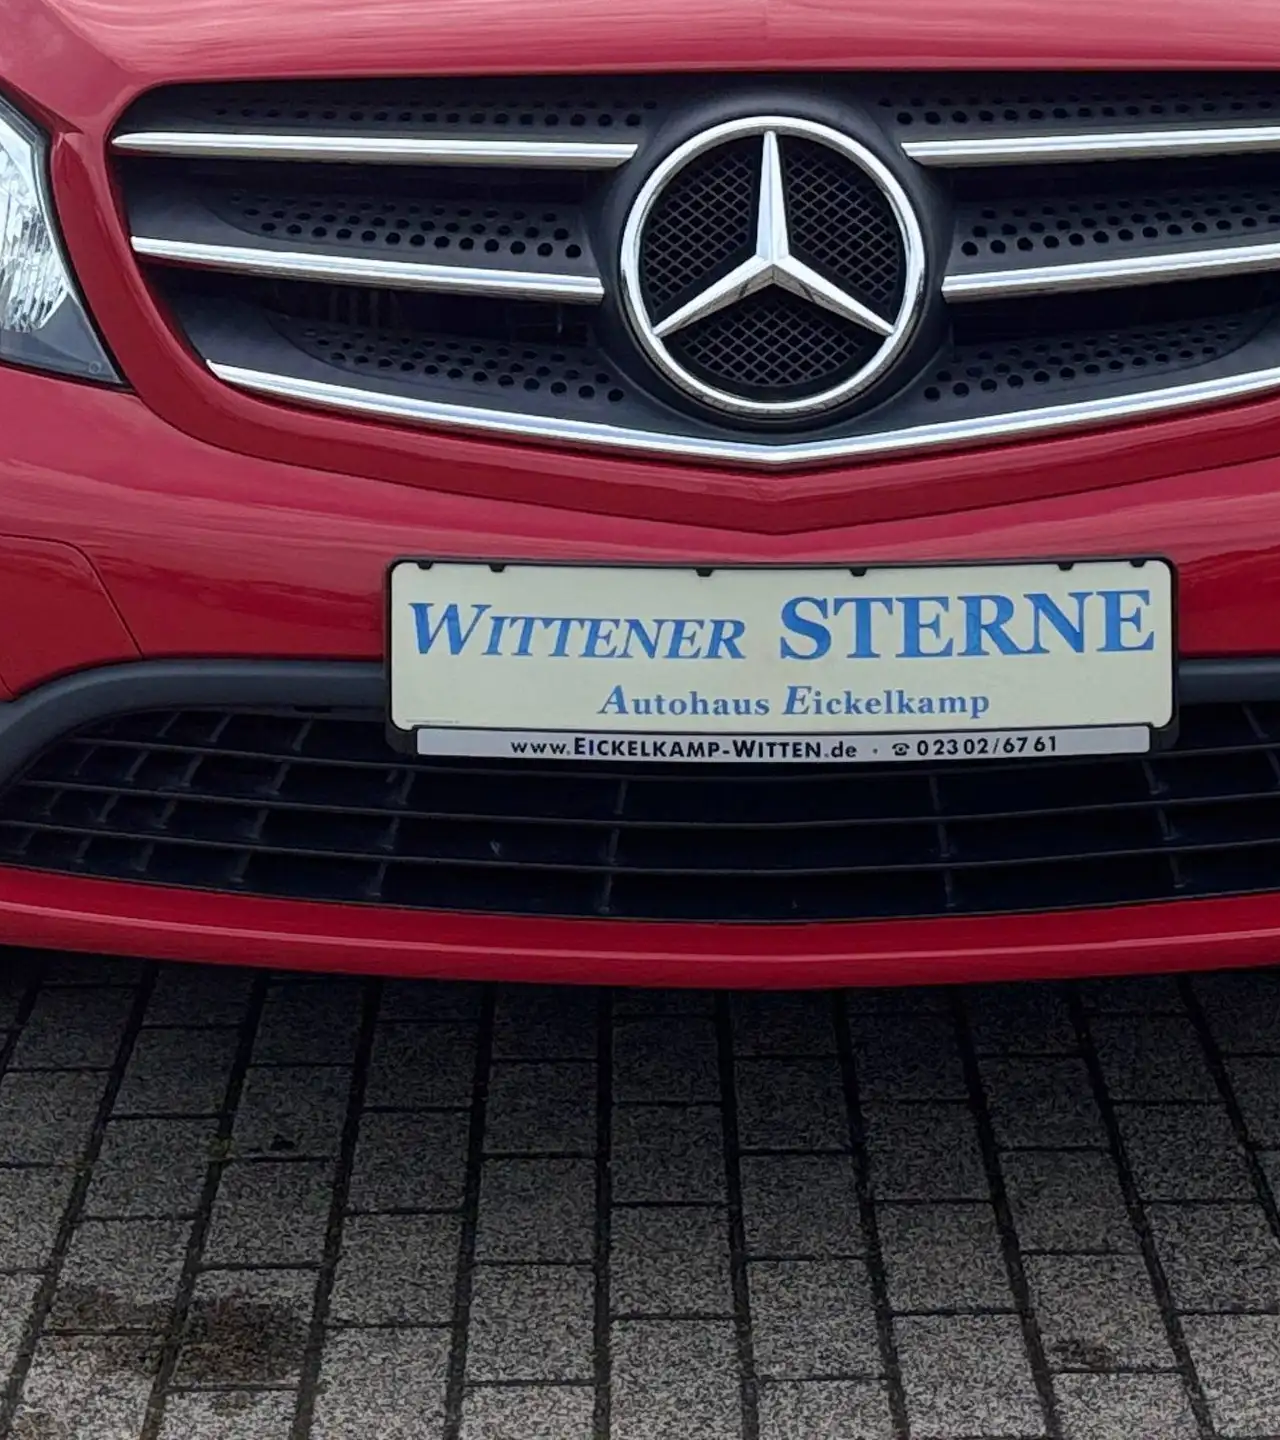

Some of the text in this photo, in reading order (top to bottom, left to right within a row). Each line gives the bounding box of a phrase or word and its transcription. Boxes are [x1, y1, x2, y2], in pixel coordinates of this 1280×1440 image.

[408, 589, 1155, 661] WITTENER STERNE
[596, 684, 990, 720] Autohaus Eickelkamp
